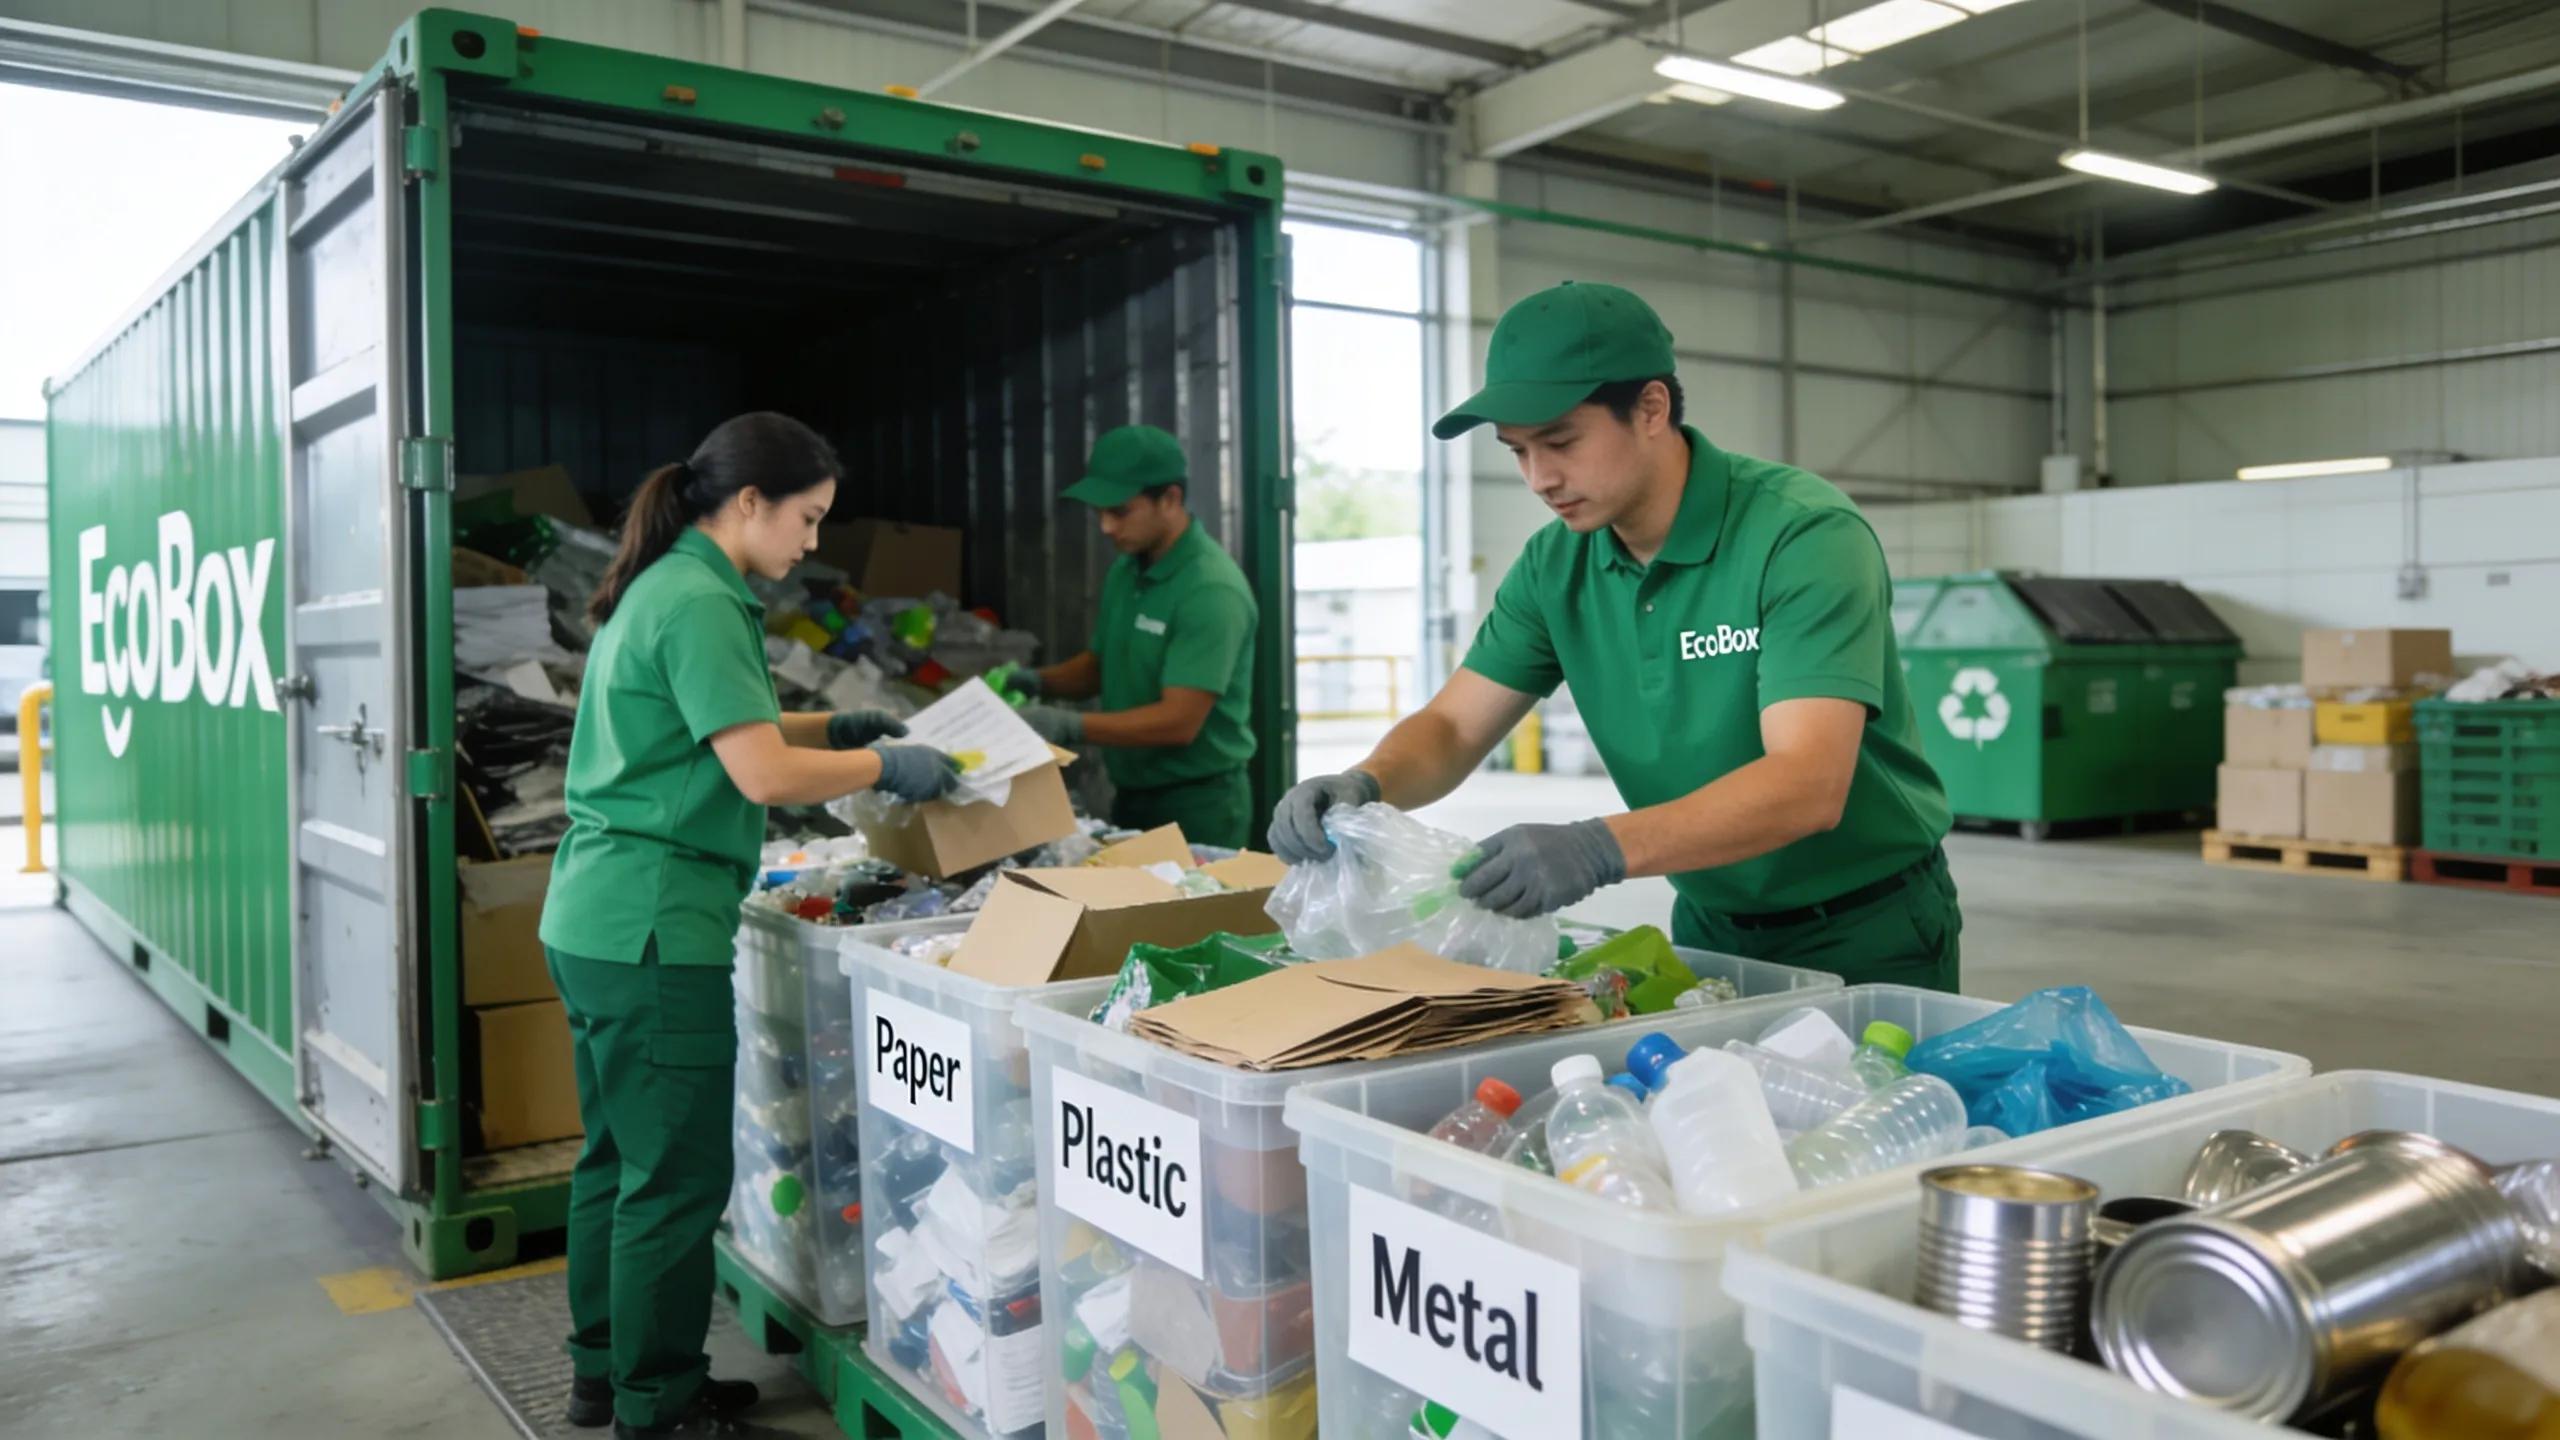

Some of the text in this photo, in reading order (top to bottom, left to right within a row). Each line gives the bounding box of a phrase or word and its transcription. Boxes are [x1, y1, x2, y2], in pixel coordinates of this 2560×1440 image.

[1680, 624, 1760, 660] EcoBox
[876, 1015, 961, 1105] Paper
[1061, 1100, 1187, 1218] Plastic
[1372, 1232, 1543, 1393] Metal
